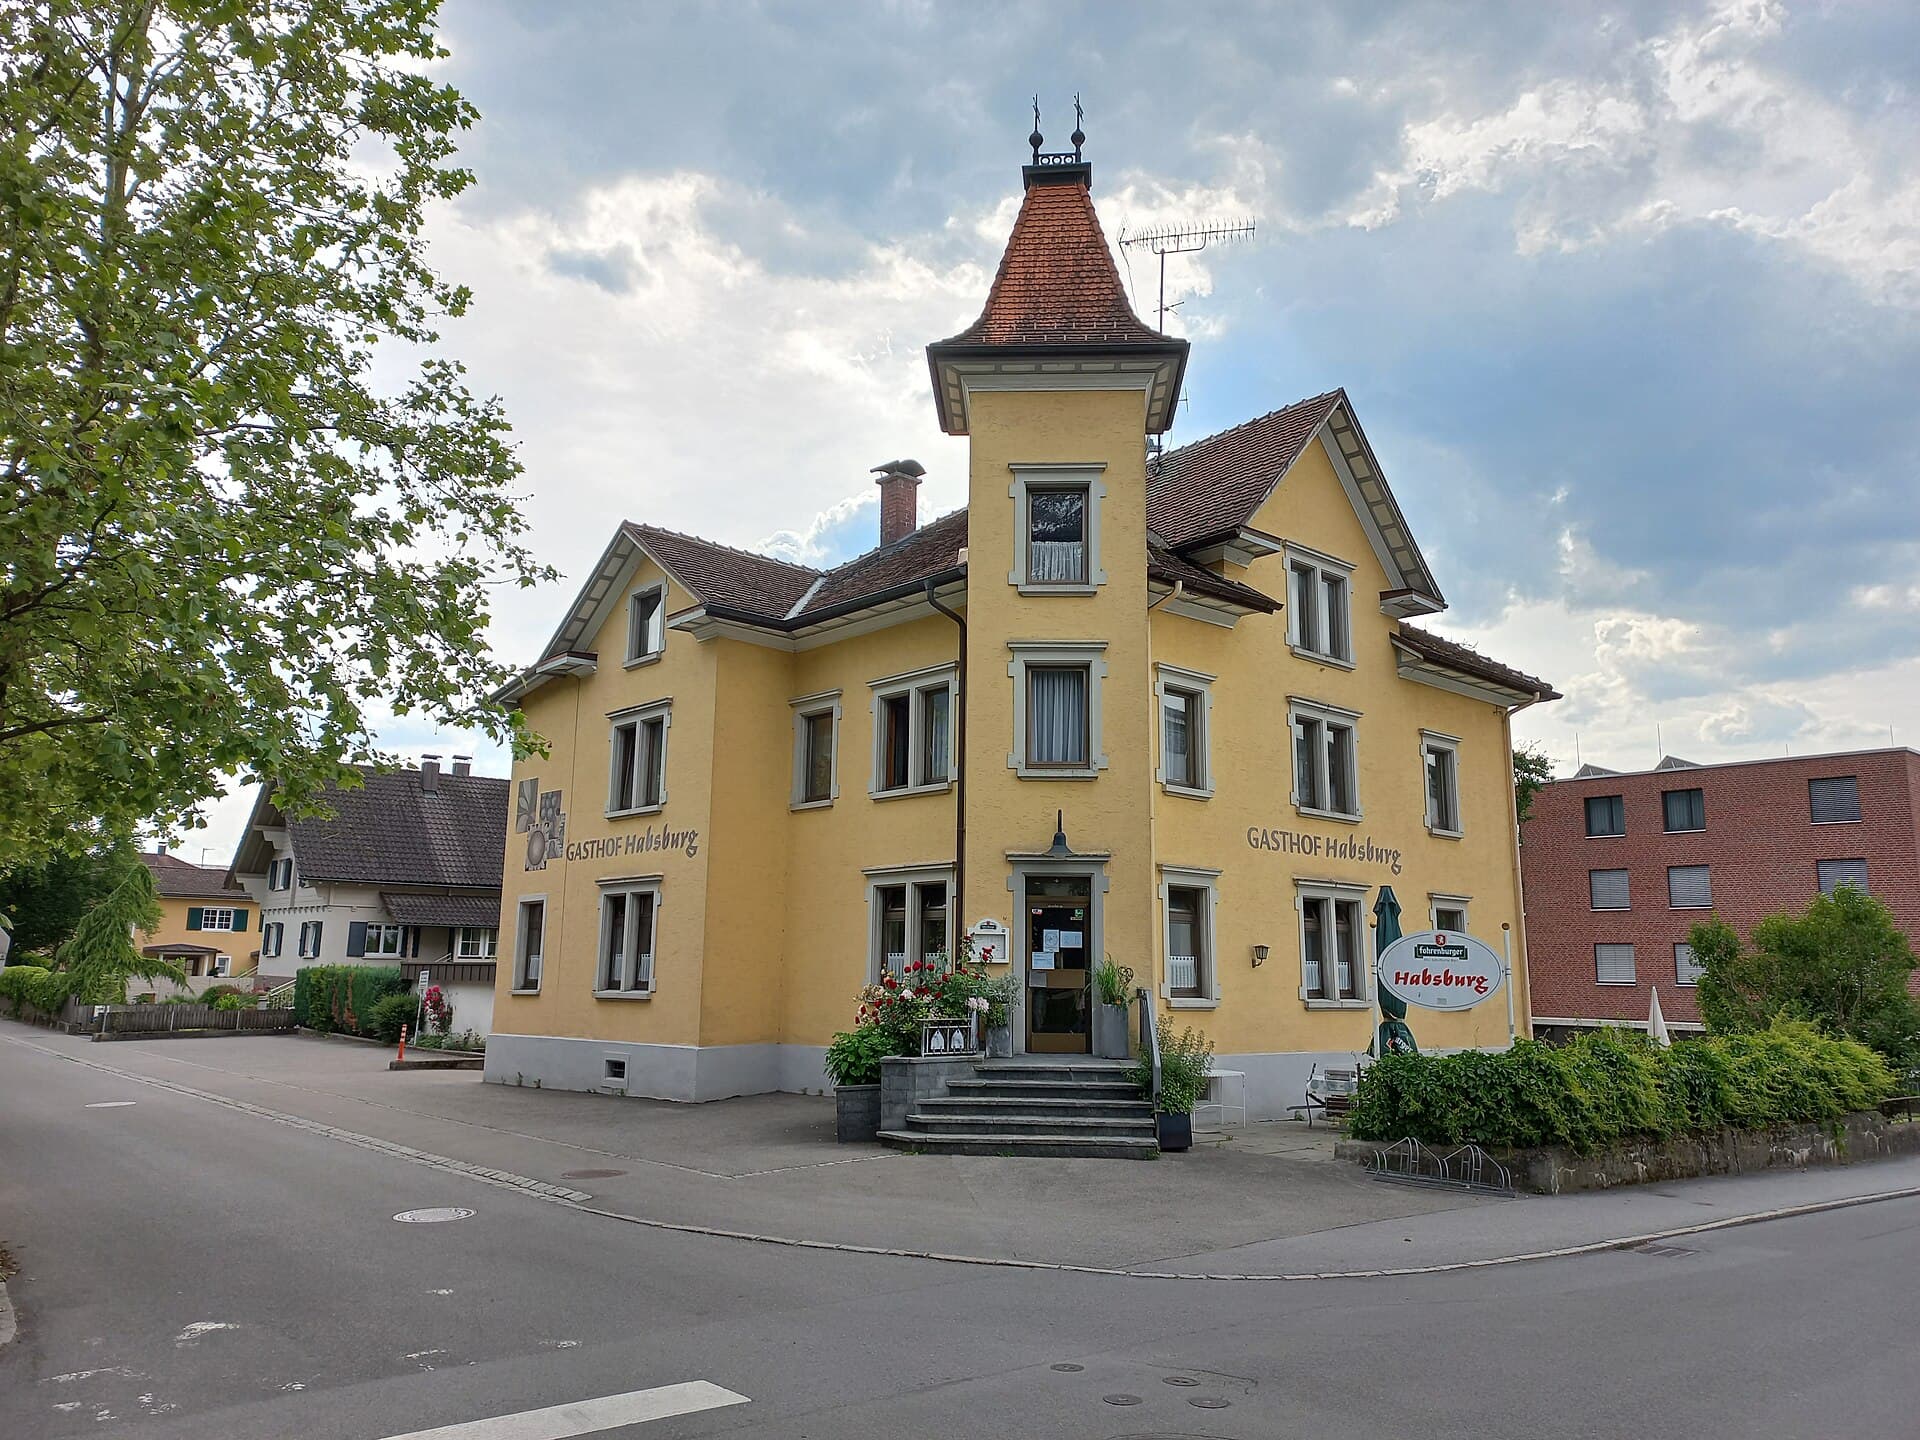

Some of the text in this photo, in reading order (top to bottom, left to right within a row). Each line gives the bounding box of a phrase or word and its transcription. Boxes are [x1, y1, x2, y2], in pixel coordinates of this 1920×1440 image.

[566, 823, 699, 862] GASTHOF Habsburg
[1247, 827, 1402, 875] GASTHOF Habsburg
[1394, 968, 1489, 995] Habsburg
